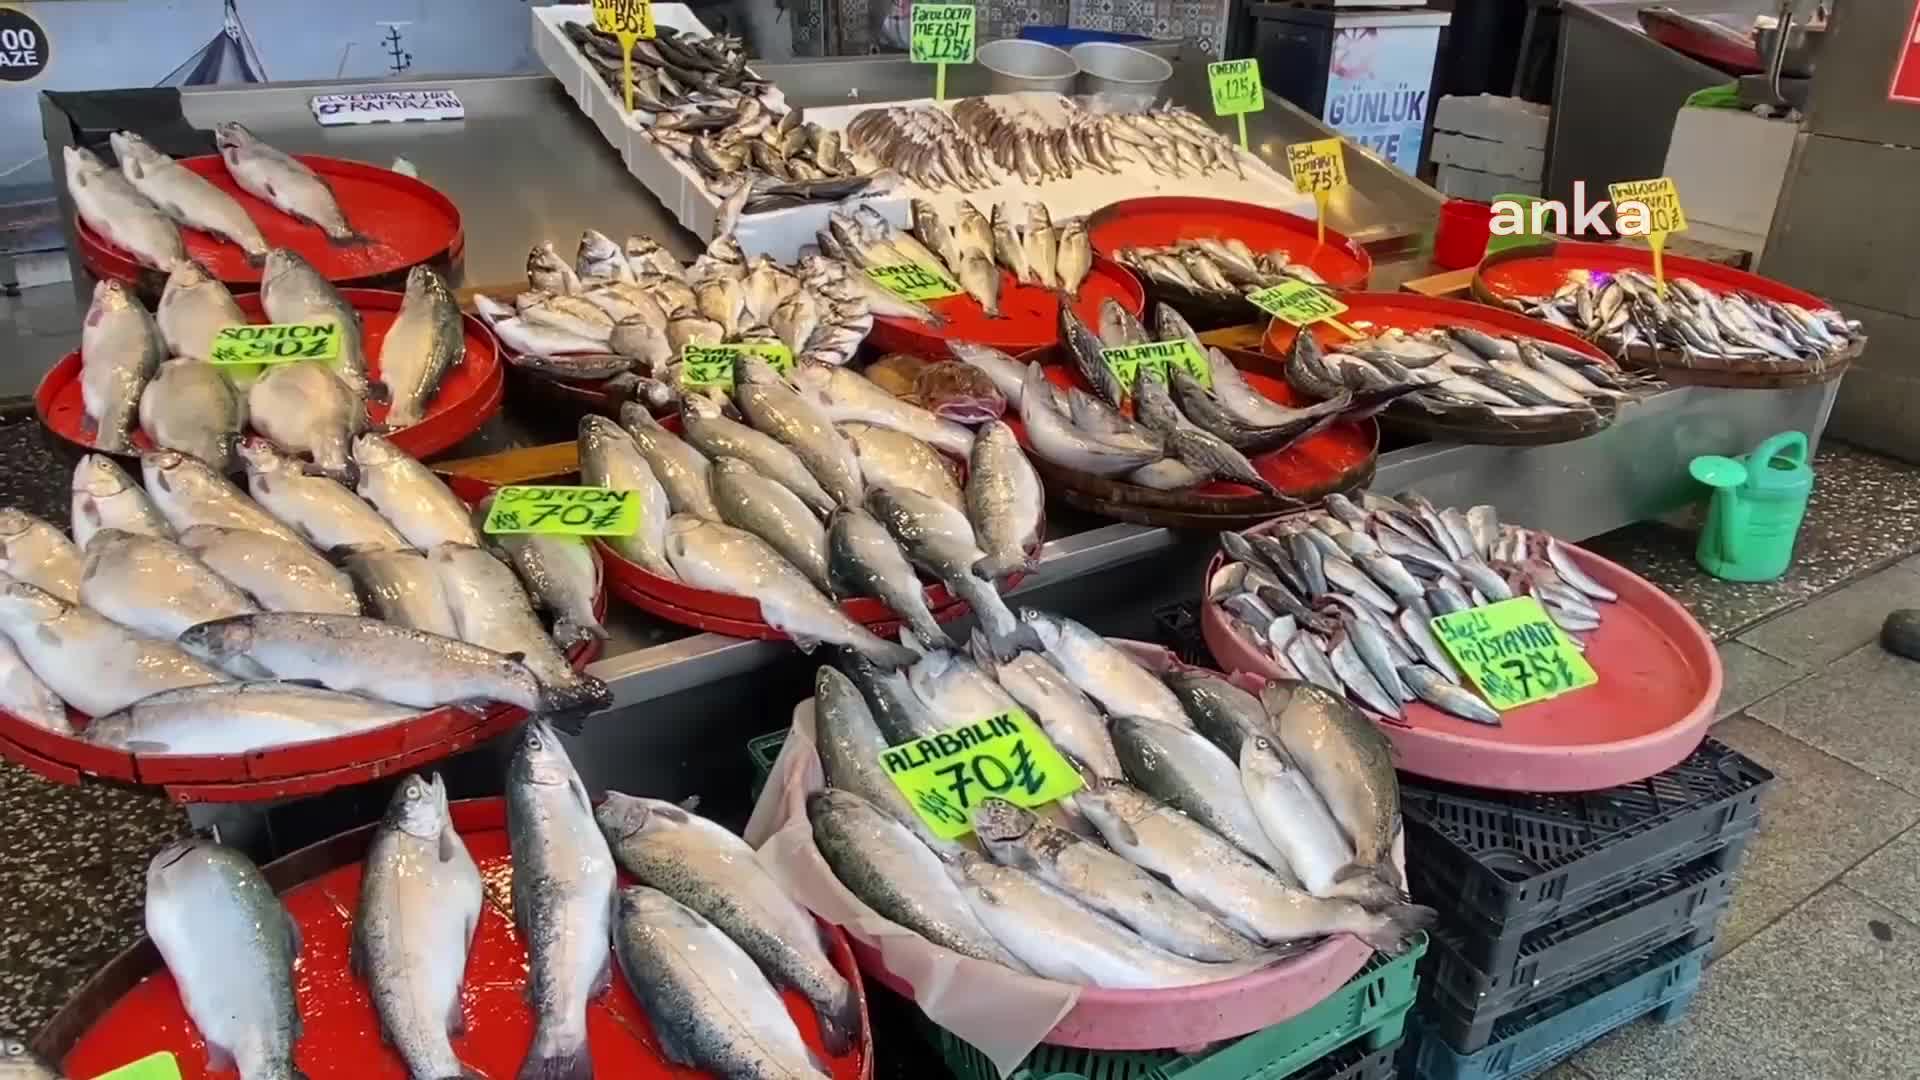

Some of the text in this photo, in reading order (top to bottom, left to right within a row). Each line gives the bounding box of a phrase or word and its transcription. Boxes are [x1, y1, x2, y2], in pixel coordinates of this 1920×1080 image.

[1329, 82, 1425, 125] GÜNLÜK
[1103, 342, 1186, 363] PALAMUT
[882, 713, 1019, 774] ALABALIK
